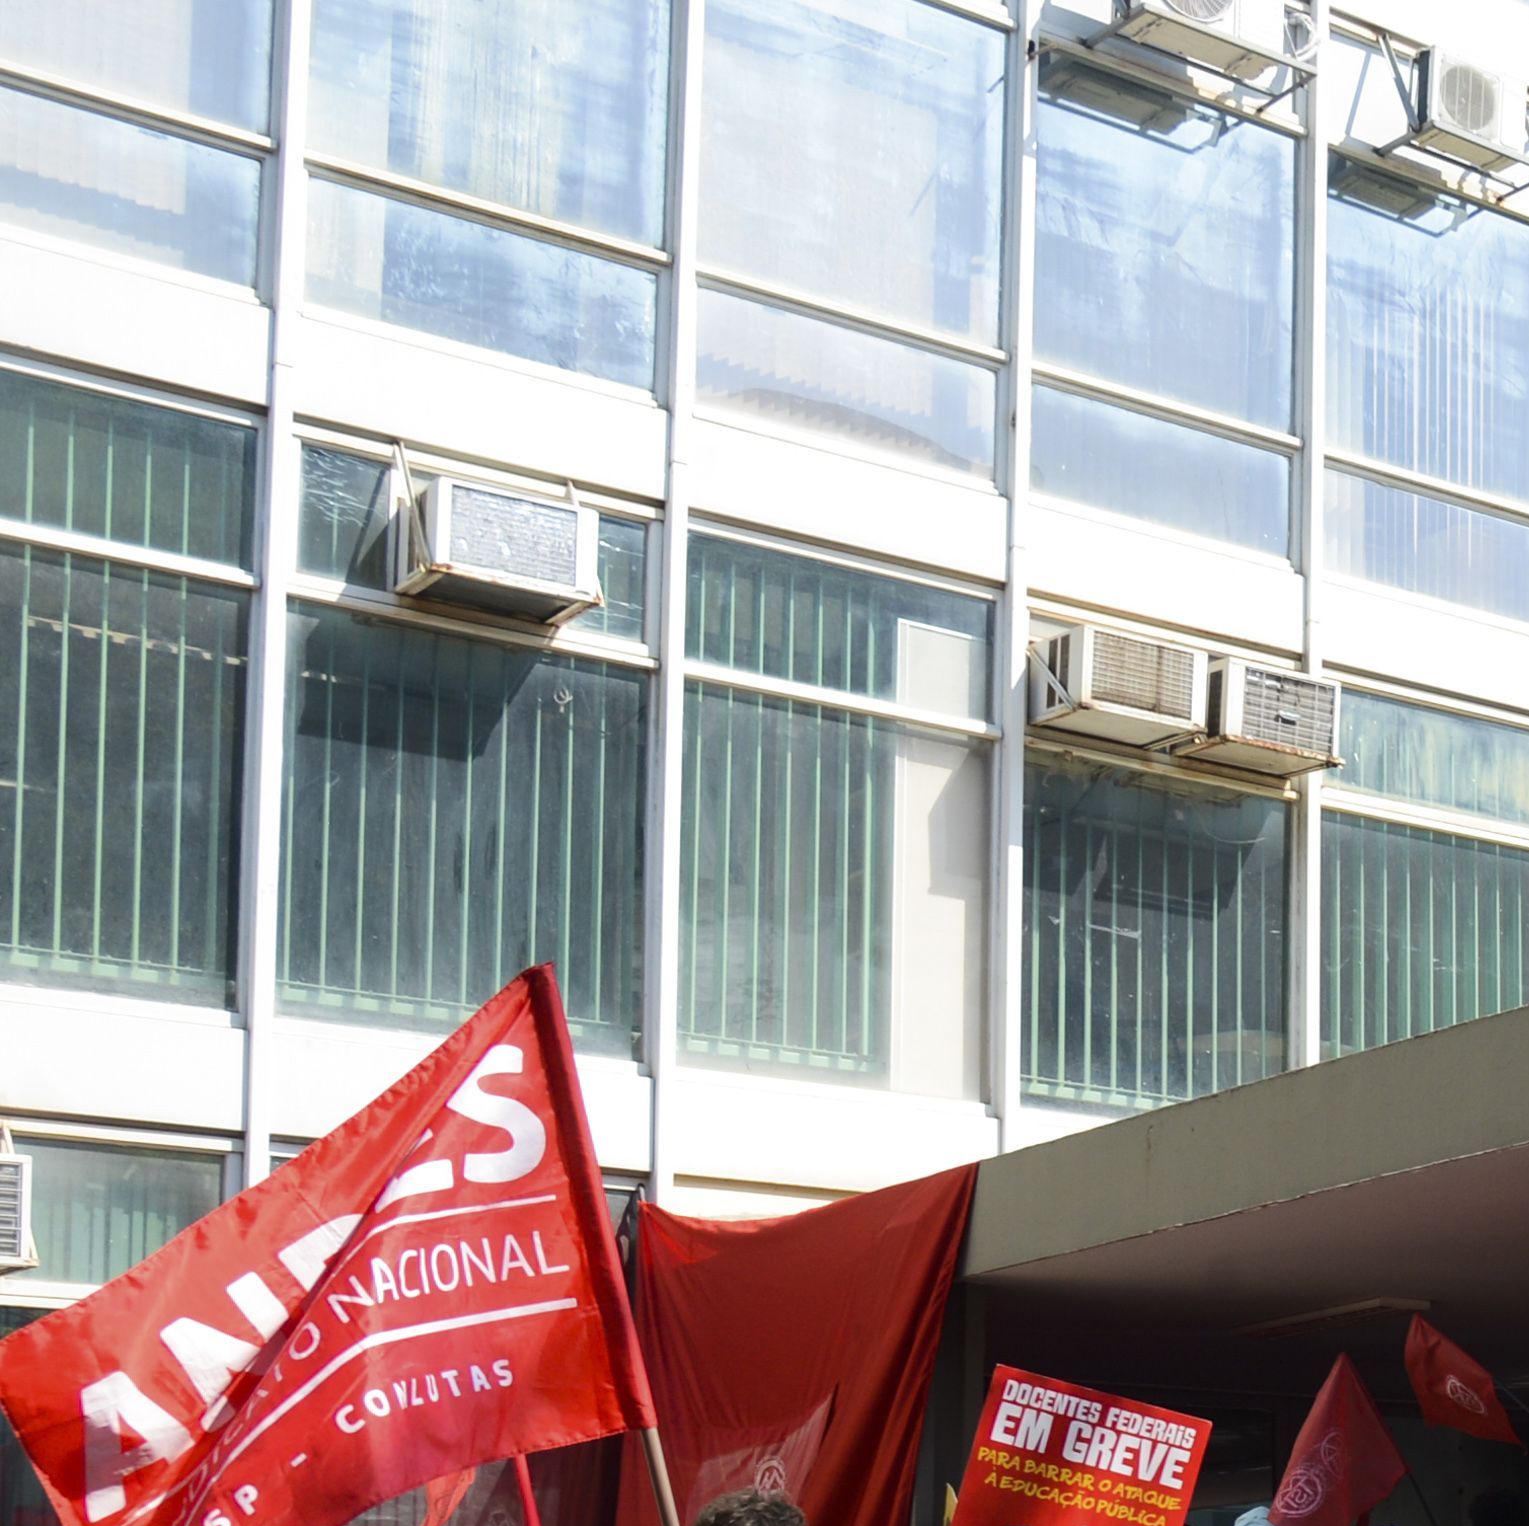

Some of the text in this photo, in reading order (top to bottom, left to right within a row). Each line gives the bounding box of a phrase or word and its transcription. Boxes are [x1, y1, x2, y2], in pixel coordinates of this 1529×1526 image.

[327, 1230, 570, 1324] NACIONAL
[335, 1359, 514, 1435] CONLUTAS
[1002, 1379, 1102, 1423] DOCENTES
[977, 1446, 1182, 1511] PARA BARRAR O ATAQUE
[990, 1402, 1192, 1490] EM GREVE
[998, 1475, 1095, 1511] EDUCAÇÃO
